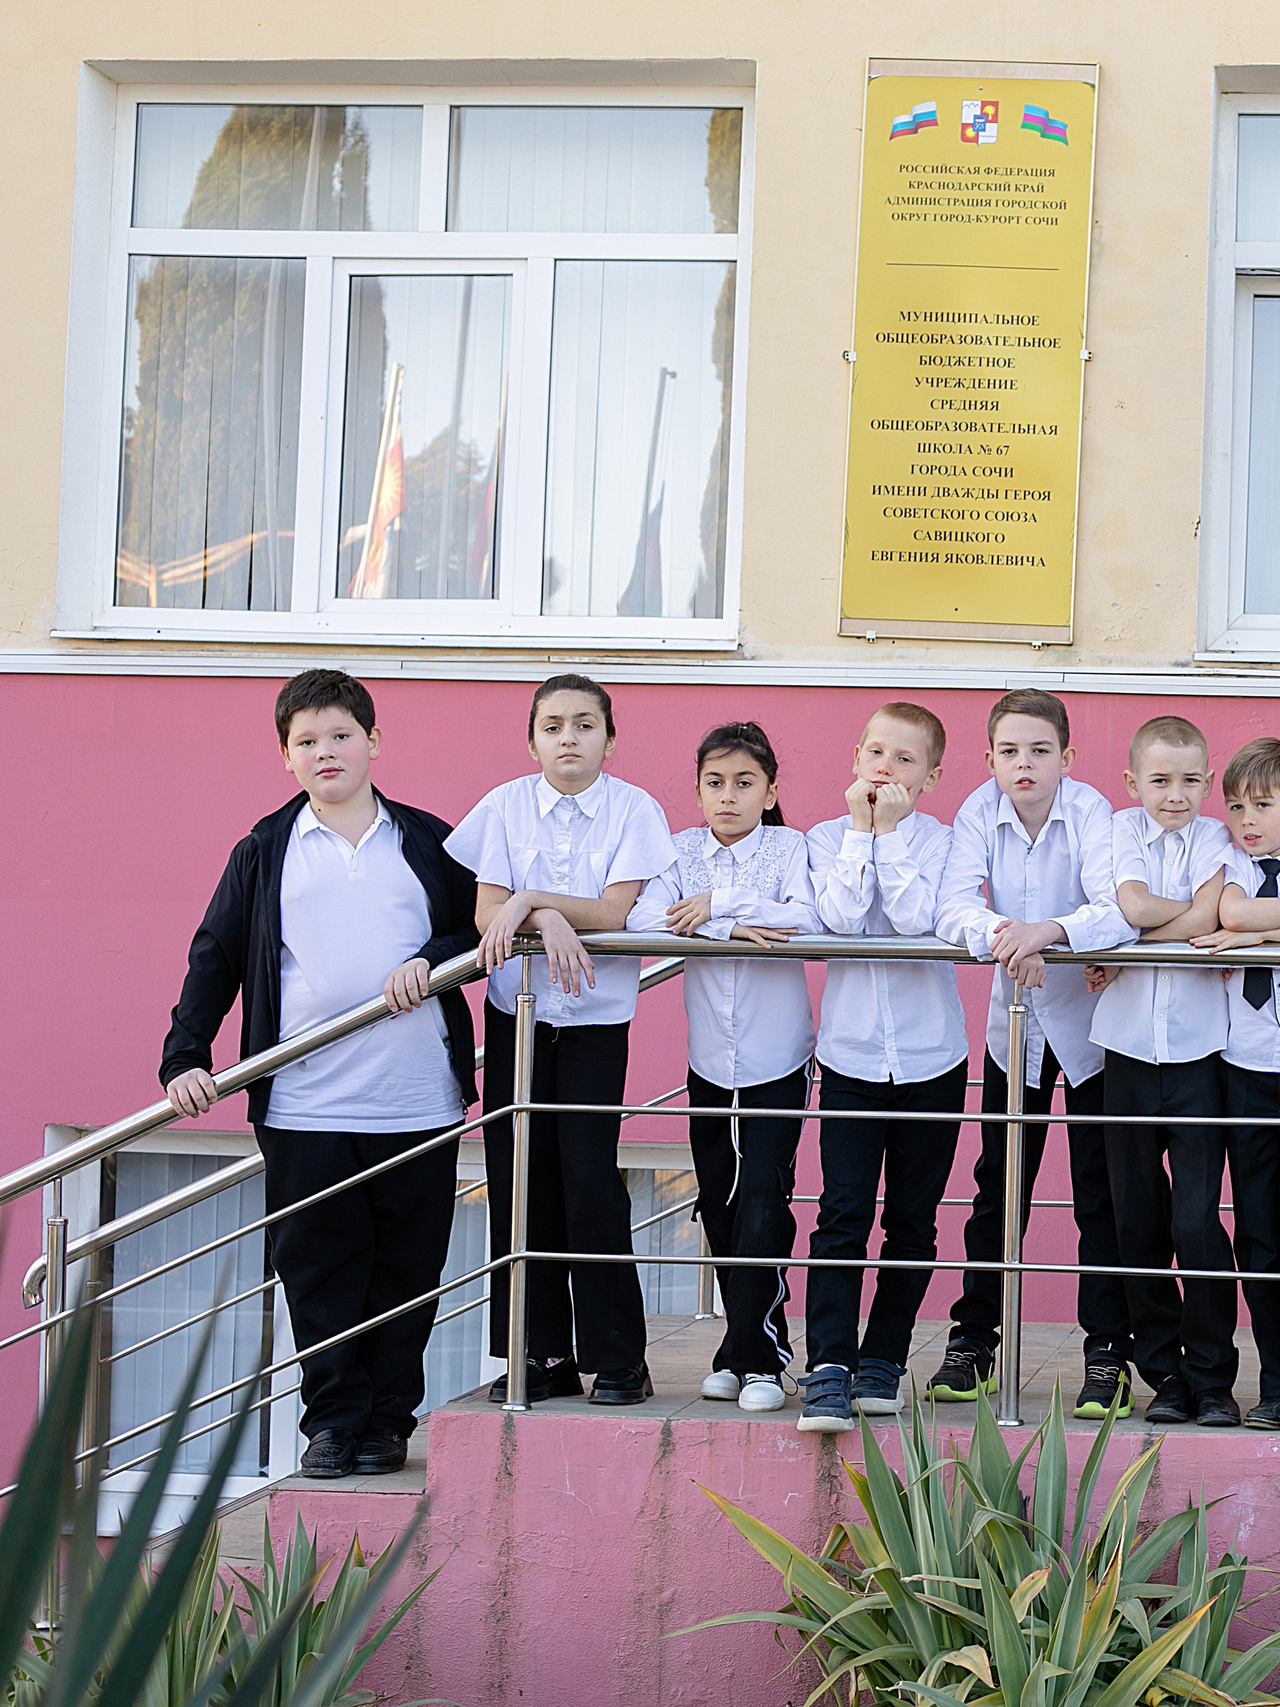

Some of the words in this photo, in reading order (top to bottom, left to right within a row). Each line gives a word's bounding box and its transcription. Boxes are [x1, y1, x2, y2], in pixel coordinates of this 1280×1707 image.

[899, 163, 980, 175] РОССИЙСКАЯ
[984, 167, 1055, 178] ФЕДЕРАЦИЯ
[909, 181, 1011, 192] КРАСНОДАРСКИЙ
[1014, 182, 1044, 193] КРАЙ
[884, 196, 991, 208] АДМИНИСТРАЦИЯ
[995, 199, 1067, 210] ГОРОДСКОЙ
[891, 212, 931, 221] ОКРУГ
[933, 213, 1022, 224] ГОРОД-КУРОРТ
[1025, 216, 1058, 226] СОЧИ
[899, 311, 1039, 326] МУНИЦИПАЛЬНОЕ
[876, 332, 1061, 348] ОБЩЕОБРАЗОВАТЕЛЬНОЕ
[919, 355, 1015, 368] БЮДЖЕТНОЕ
[915, 377, 1018, 390] УЧРЕЖДЕНИЕ
[930, 399, 999, 412] СРЕДНЯЯ
[871, 419, 1057, 435] ОБЩЕОБРАЗОВАТЕЛЬНАЯ
[918, 443, 973, 454] ШКОЛА
[977, 444, 992, 455] №
[996, 445, 1010, 456] 67
[911, 464, 967, 477] ГОРОДА
[972, 466, 1013, 478] СОЧИ
[872, 485, 927, 496] ИМЕНИ
[931, 487, 999, 500] ДВАЖДЫ
[1005, 489, 1051, 501] ГЕРОЯ
[883, 507, 980, 520] СОВЕТСКОГО
[985, 510, 1037, 523] СОЮЗА
[913, 530, 1005, 544] САВИЦКОГО
[871, 550, 939, 563] ЕВГЕНИЯ
[944, 553, 1045, 567] ЯКОВЛЕВИЧА
